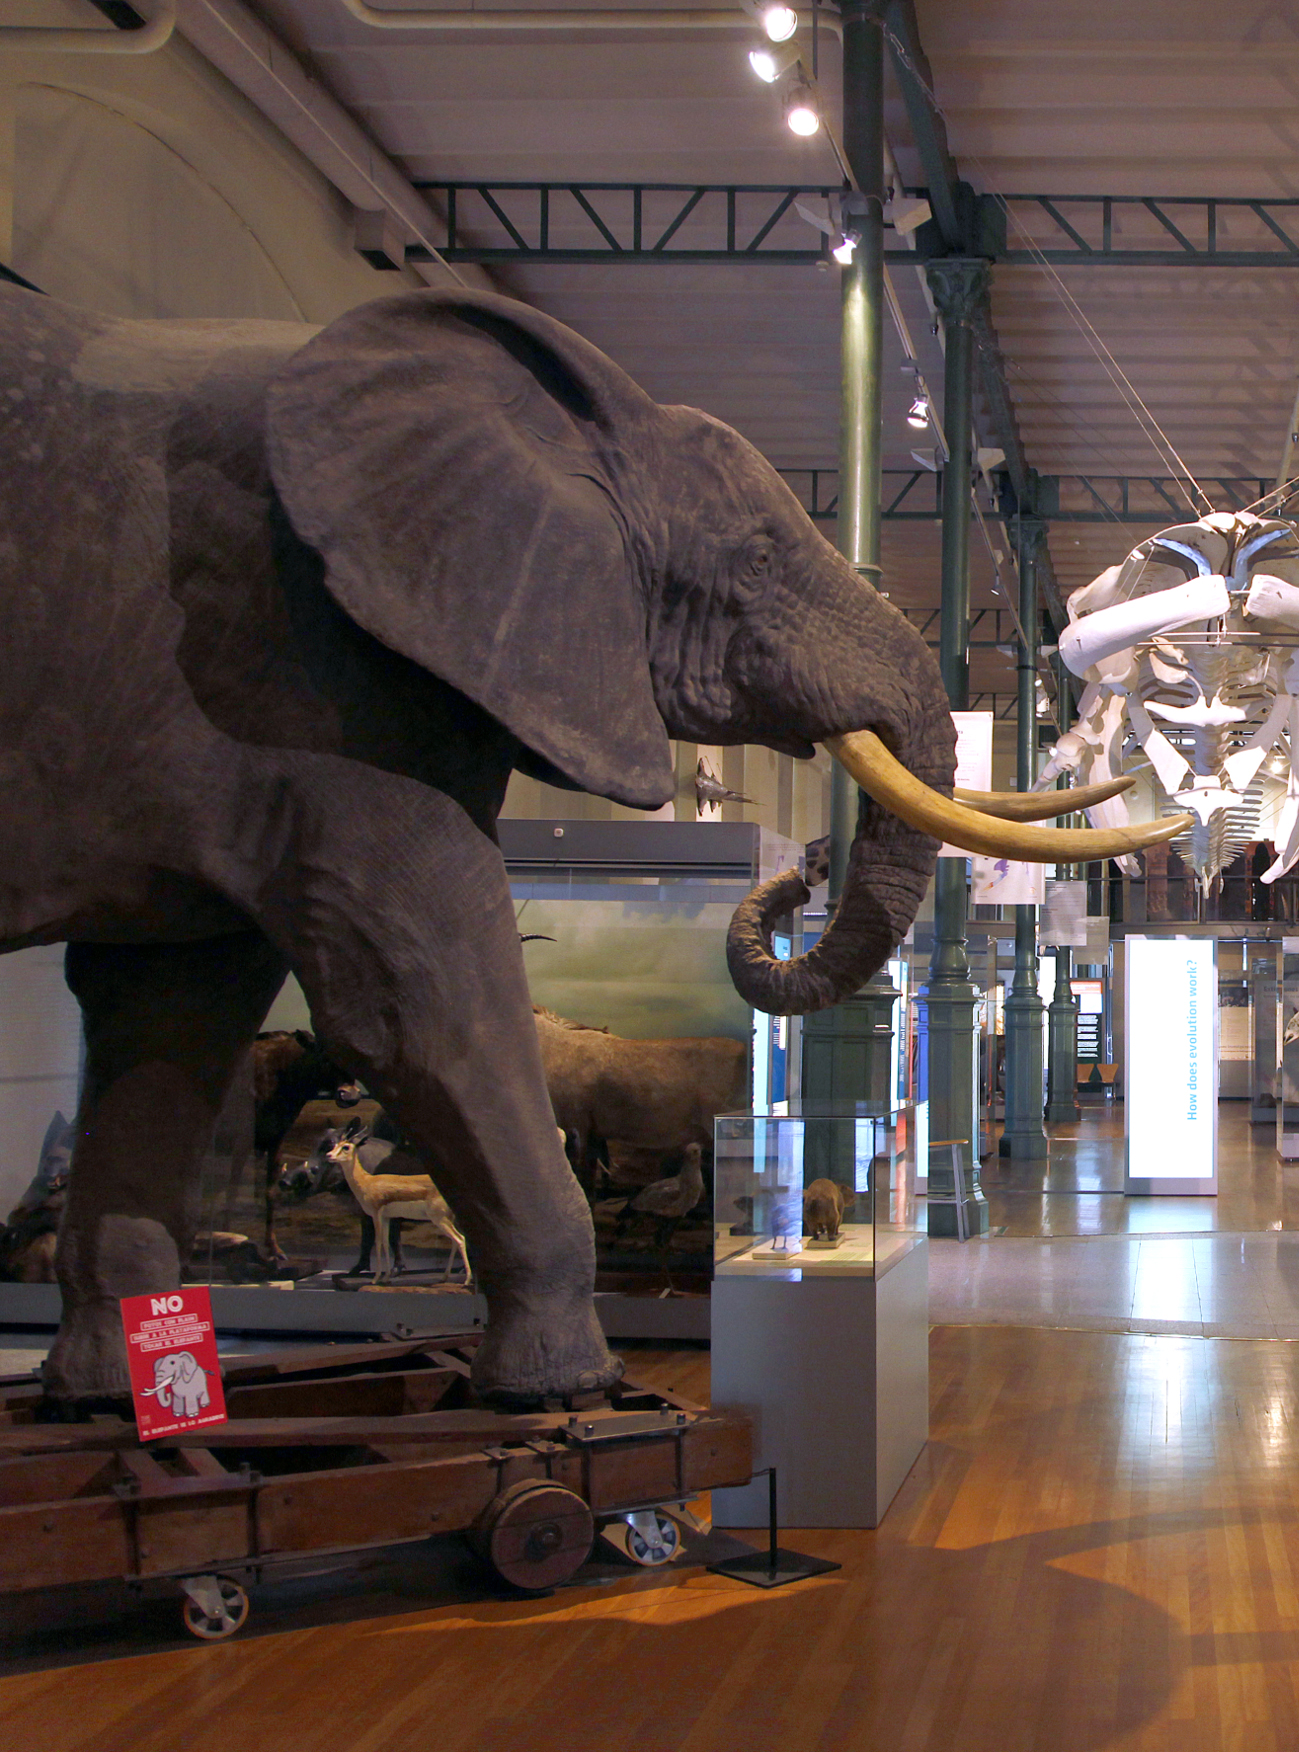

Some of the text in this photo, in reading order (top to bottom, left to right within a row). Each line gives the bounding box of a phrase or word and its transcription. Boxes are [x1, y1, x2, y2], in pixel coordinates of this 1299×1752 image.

[1186, 959, 1198, 1121] How does evolution work?
[150, 1295, 184, 1316] NO
